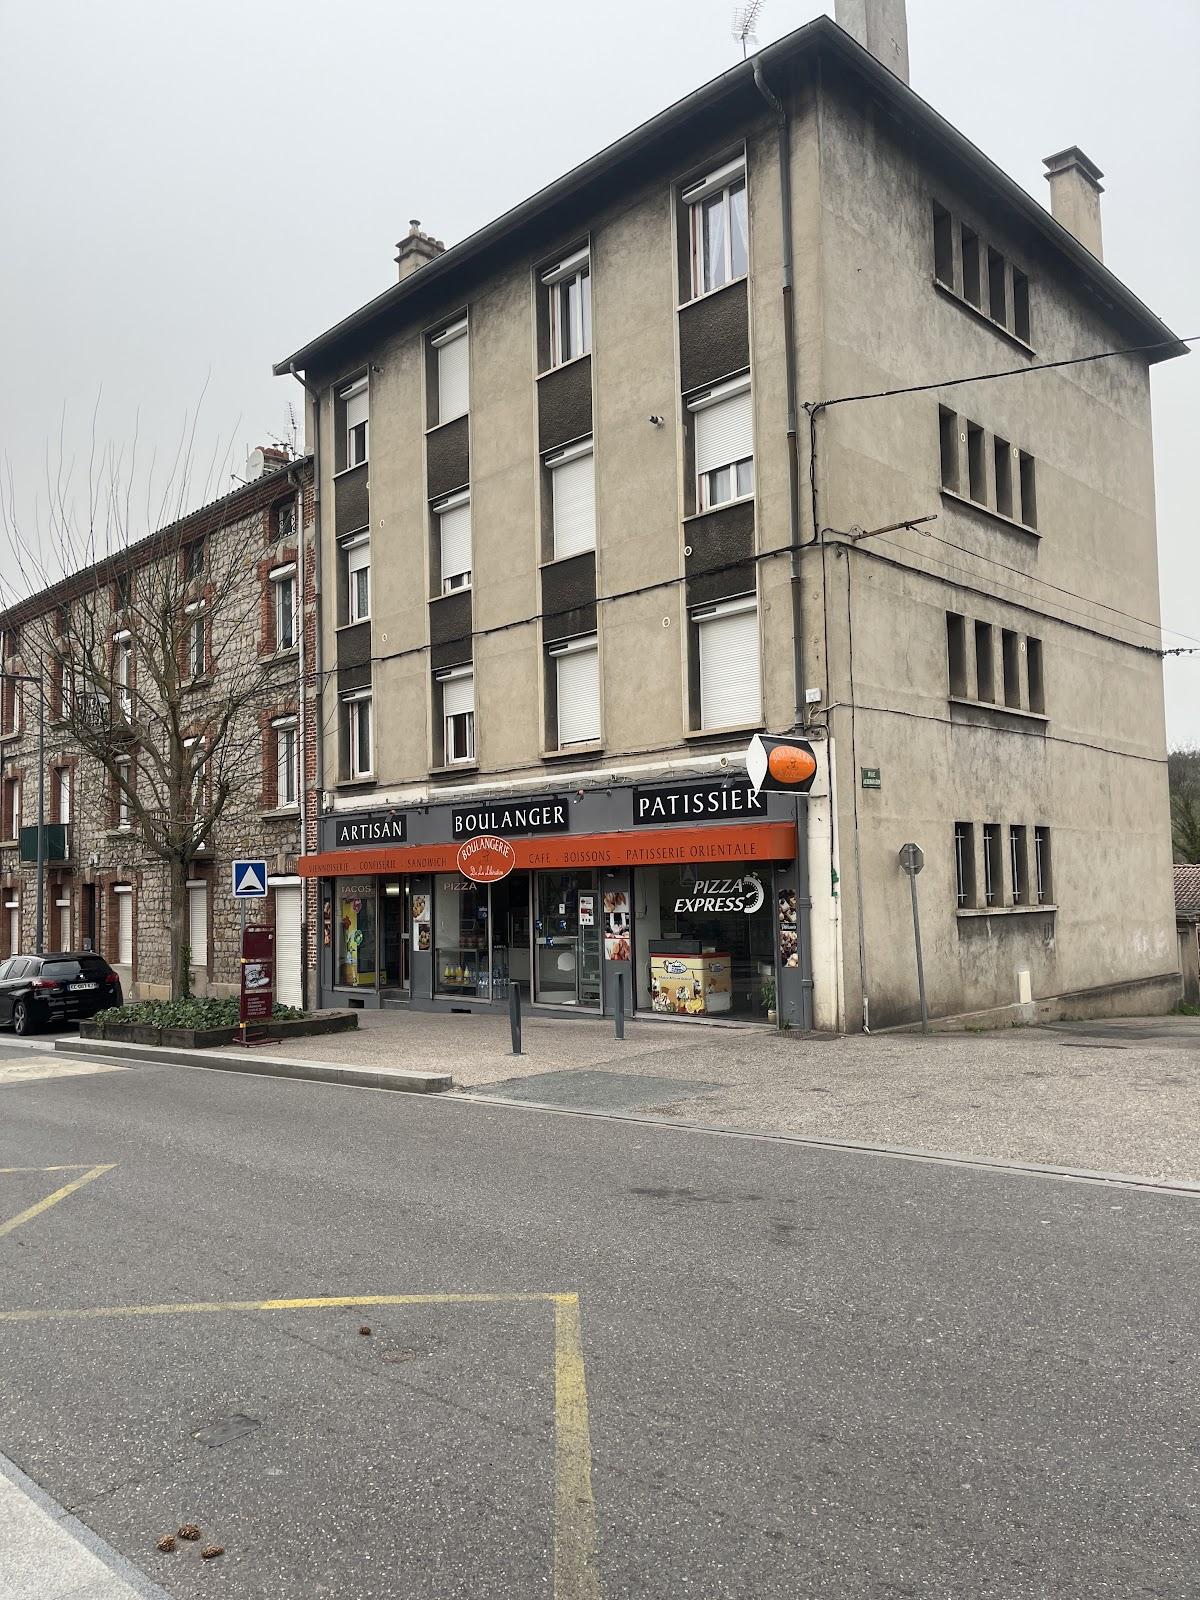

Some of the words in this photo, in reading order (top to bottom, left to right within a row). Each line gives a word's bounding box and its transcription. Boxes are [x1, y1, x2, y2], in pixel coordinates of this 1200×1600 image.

[639, 788, 761, 817] PATISSIER
[455, 806, 565, 832] BOULANGER
[341, 821, 402, 841] ARTISAN
[461, 837, 510, 860] BOULANGERIE
[564, 850, 611, 863] BOISSONS
[626, 847, 685, 860] PATISSERIE
[690, 843, 756, 857] ORIENTALE
[308, 863, 349, 873] VIENNOISERIE
[359, 860, 396, 871] CONFISERIE
[407, 857, 447, 868] SANDWICH
[341, 885, 372, 893] TACOS
[443, 882, 477, 891] PIZZA
[693, 878, 743, 894] PIZZA
[674, 897, 745, 913] EXPRESS
